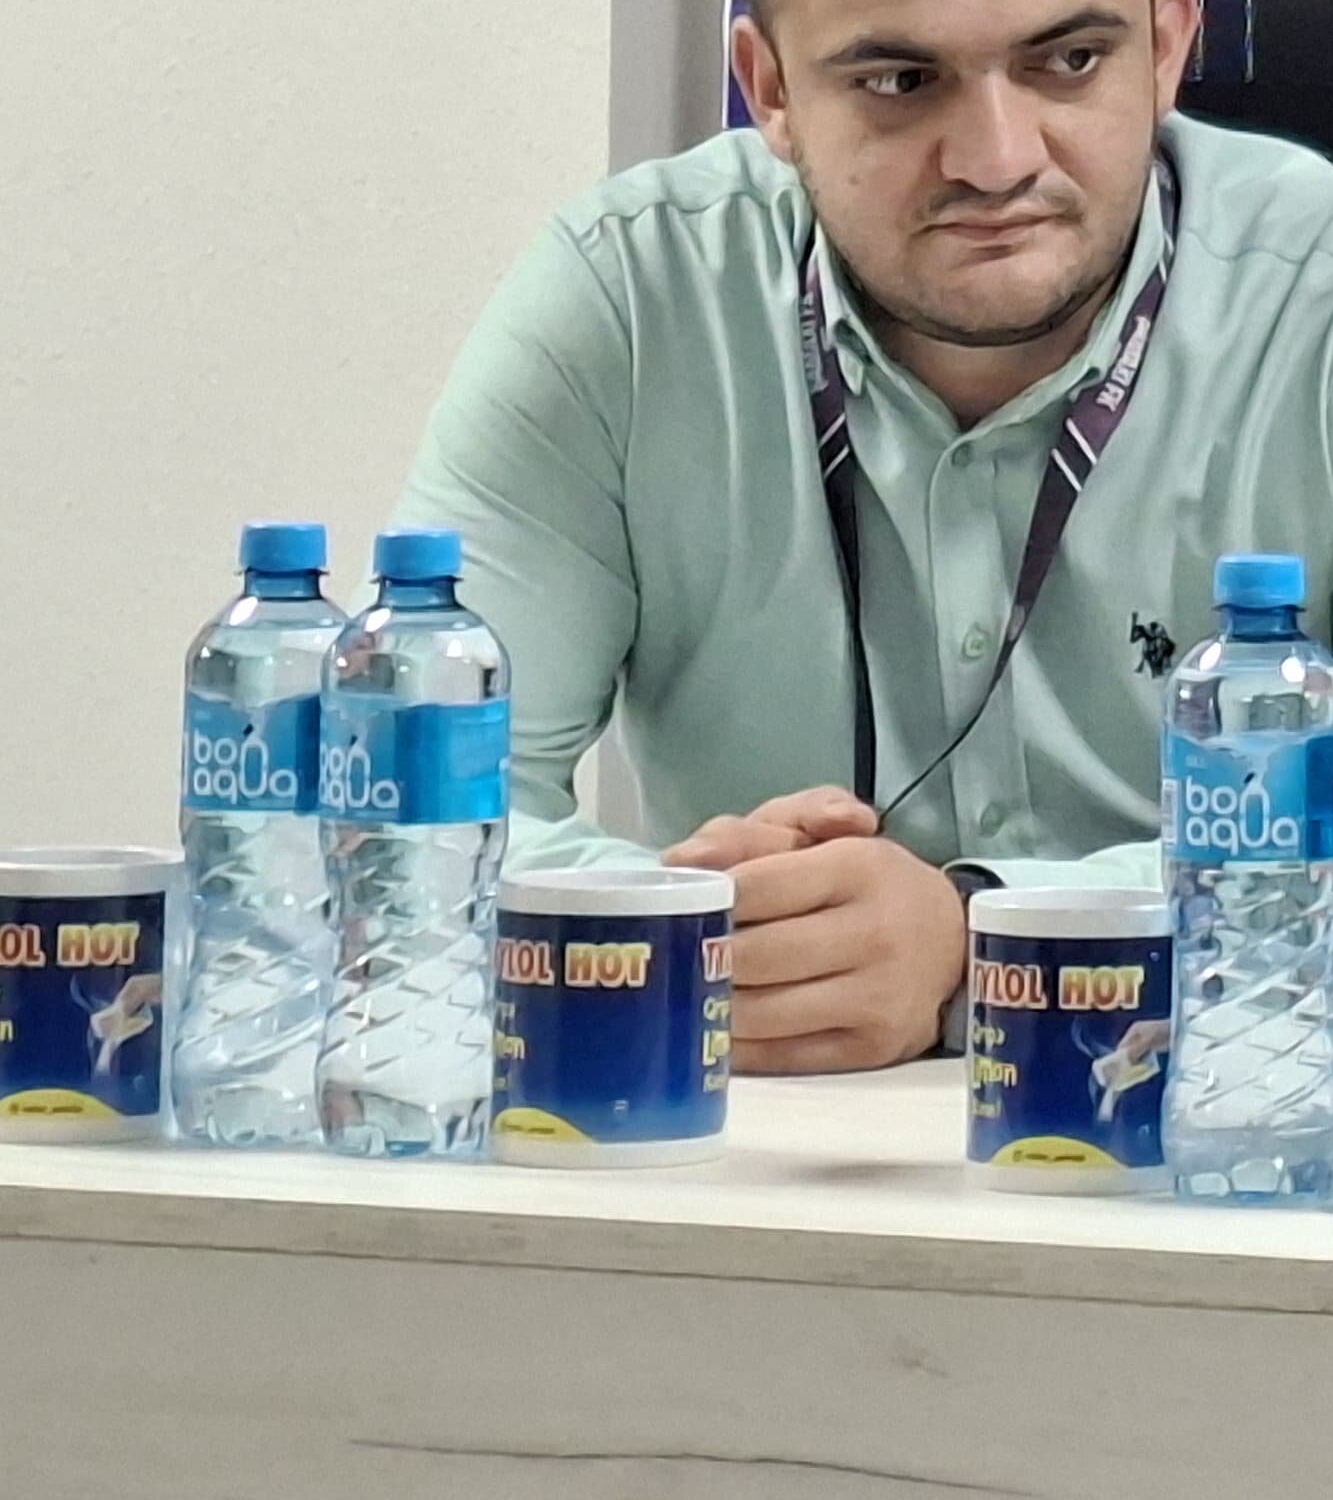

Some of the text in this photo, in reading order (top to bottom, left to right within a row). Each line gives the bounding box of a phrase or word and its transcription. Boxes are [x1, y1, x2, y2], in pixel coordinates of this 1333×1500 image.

[1186, 815, 1300, 854] aqua
[57, 923, 140, 967] HOT
[565, 942, 651, 988] HOT
[1059, 965, 1145, 1010] HOT
